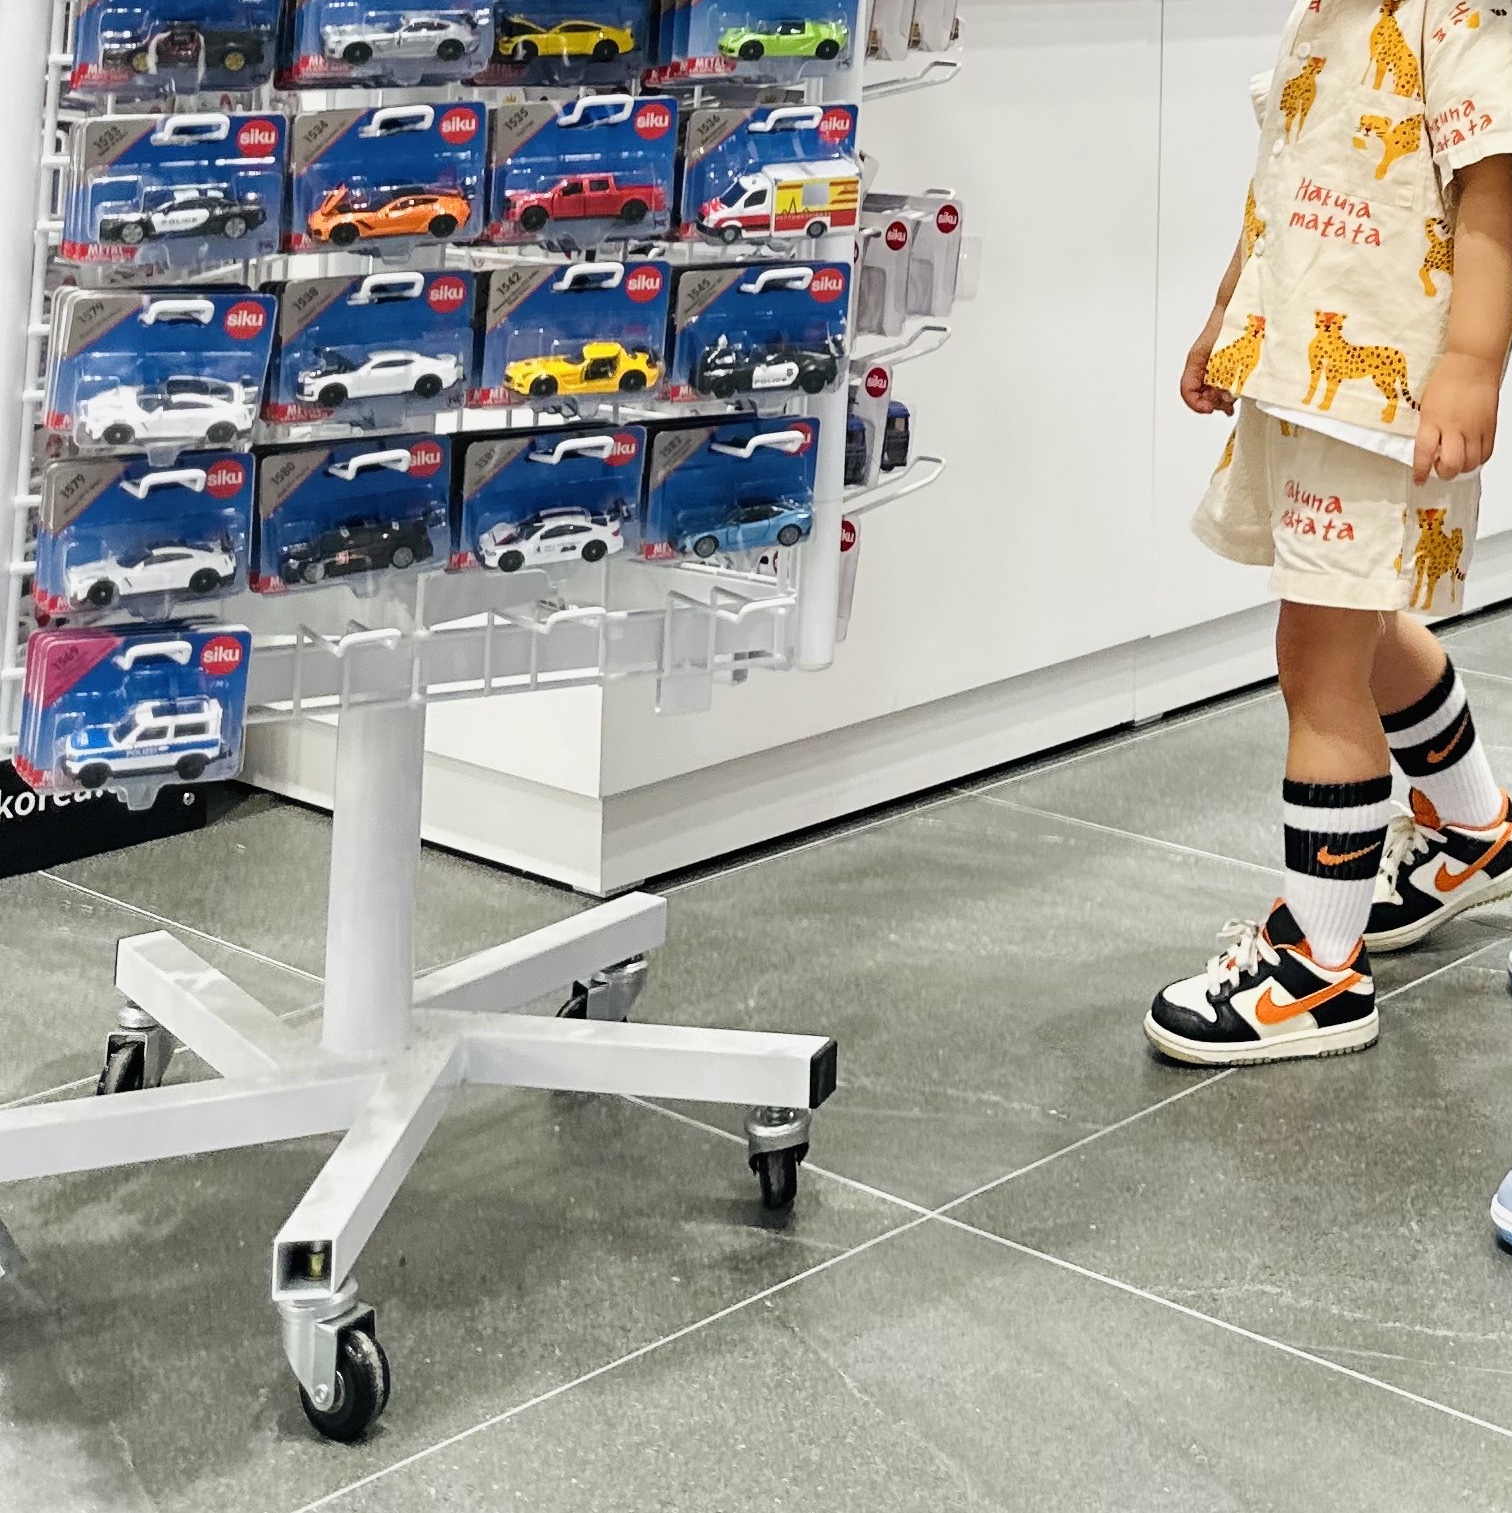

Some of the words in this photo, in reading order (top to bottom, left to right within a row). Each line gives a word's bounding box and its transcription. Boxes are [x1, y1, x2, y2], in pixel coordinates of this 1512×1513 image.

[442, 117, 476, 133] siku
[636, 113, 669, 129] siku
[820, 118, 850, 134] siku
[239, 129, 275, 146] siku
[1294, 177, 1372, 219] Hakuna
[1289, 209, 1381, 246] matata
[628, 274, 660, 291] siku
[812, 277, 842, 293] siku
[430, 285, 464, 302] siku
[226, 311, 263, 329] siku
[207, 468, 242, 487] siku
[203, 648, 240, 663] siku
